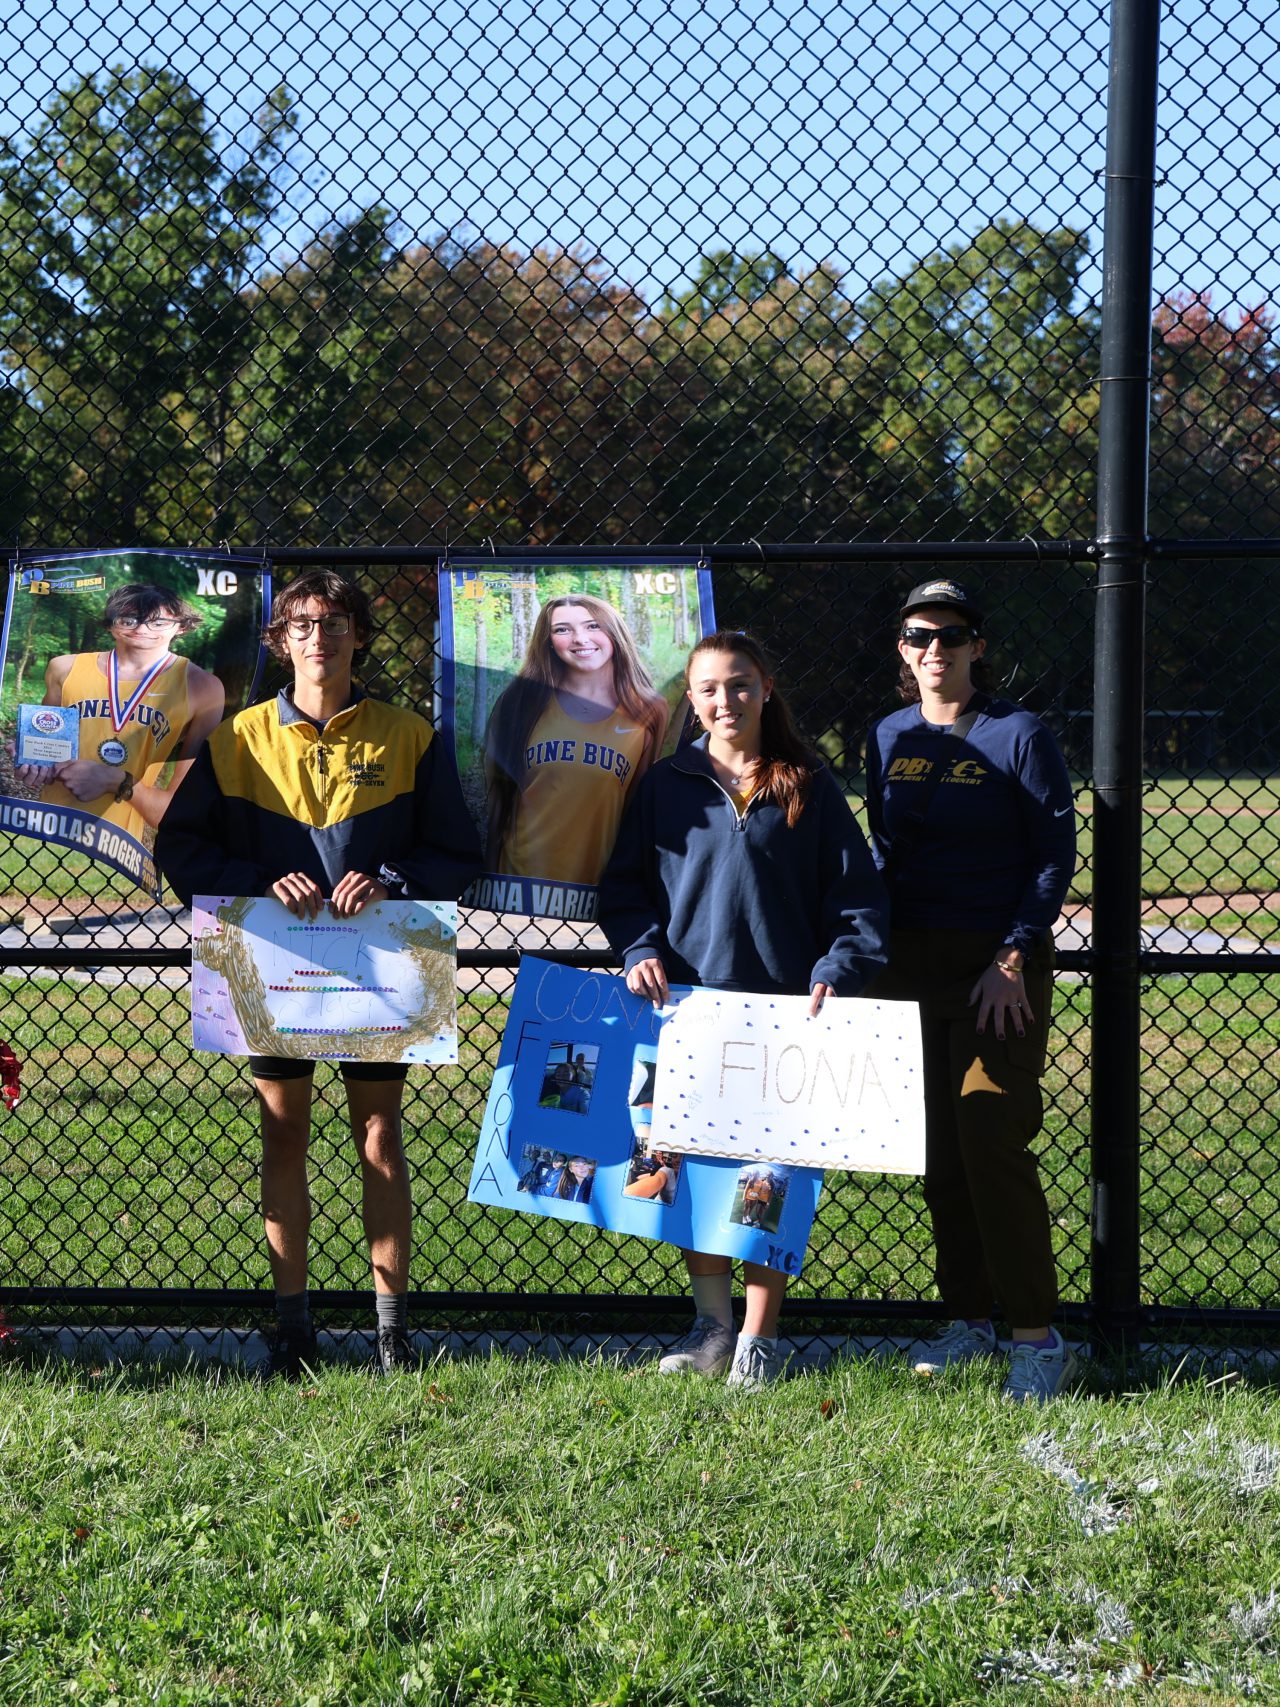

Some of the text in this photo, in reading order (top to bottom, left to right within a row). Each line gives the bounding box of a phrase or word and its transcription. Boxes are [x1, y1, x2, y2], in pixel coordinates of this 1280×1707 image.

[76, 577, 103, 588] BUSH
[196, 568, 238, 596] XC
[633, 572, 676, 595] XC
[367, 763, 385, 772] BUSH
[526, 740, 631, 785] PINE BUSH
[887, 757, 927, 776] PB
[97, 827, 141, 878] ROGERS
[719, 1040, 892, 1108] FIONA
[765, 1244, 799, 1272] XC
